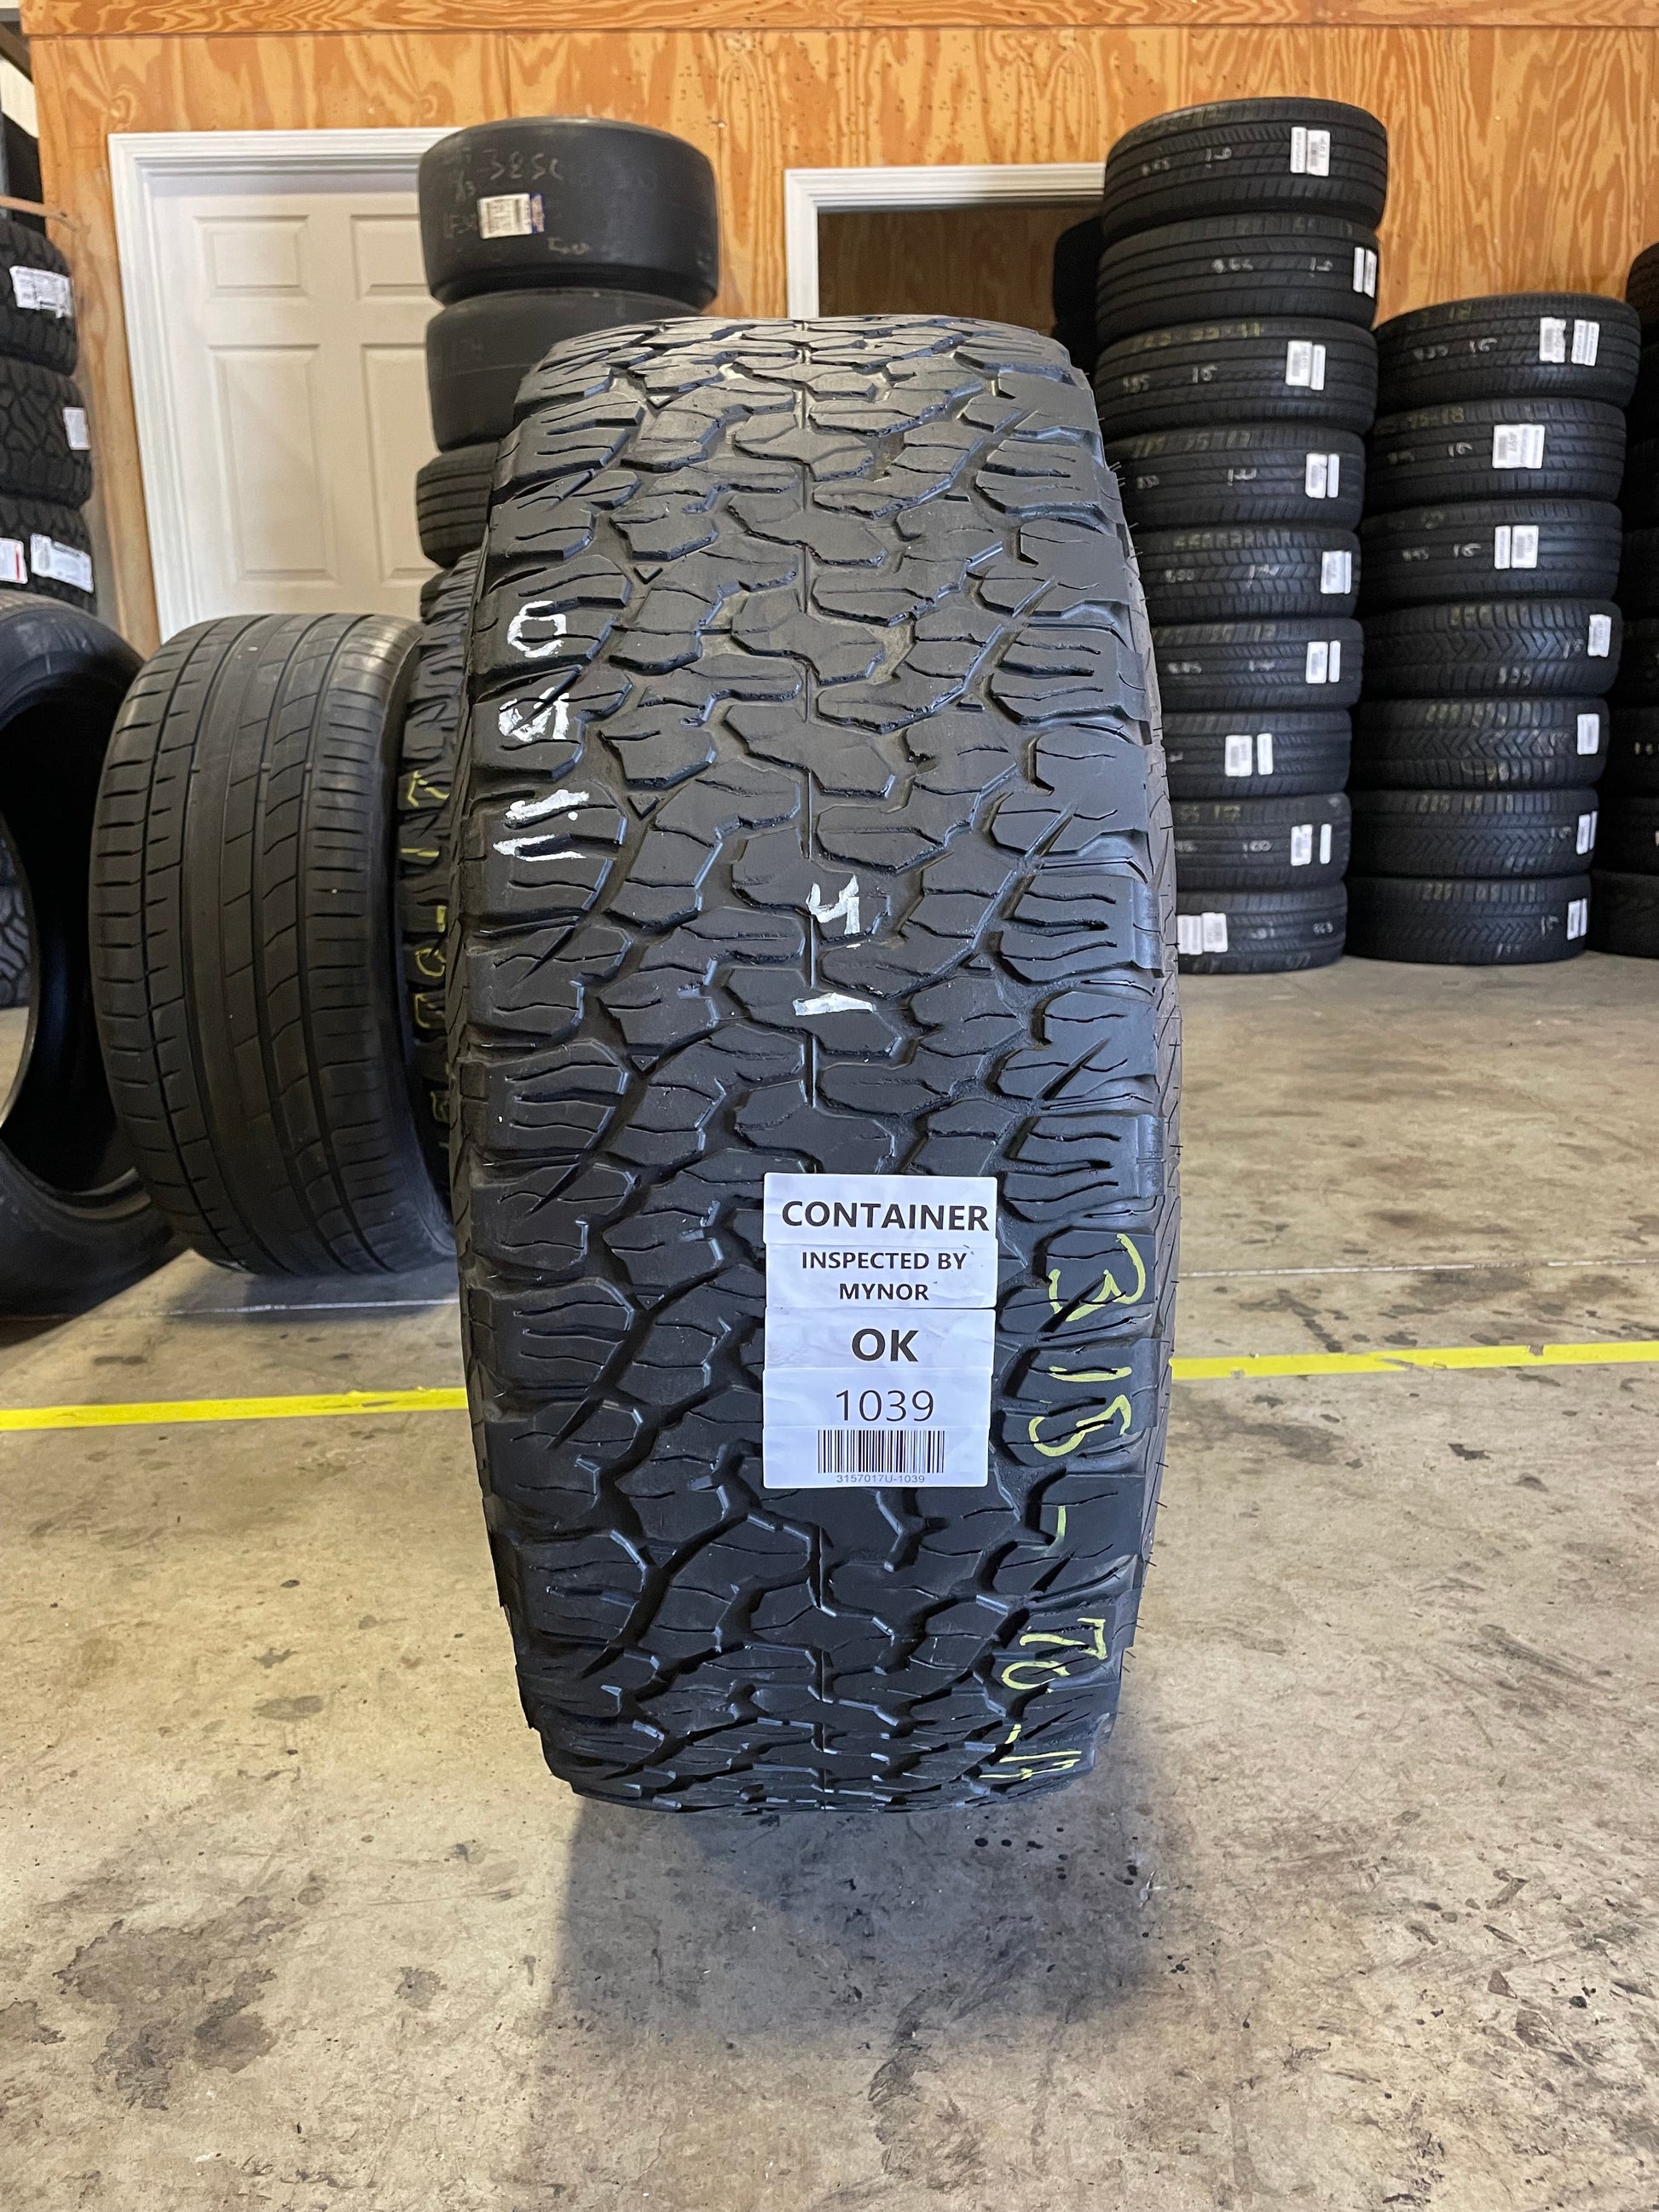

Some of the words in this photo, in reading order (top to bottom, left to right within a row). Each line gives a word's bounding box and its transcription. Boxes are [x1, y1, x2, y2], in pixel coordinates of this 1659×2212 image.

[782, 1200, 990, 1232] CONTAINER
[801, 1251, 930, 1270] INSPECTED
[938, 1252, 968, 1270] BY
[839, 1283, 930, 1302] MYNOR
[851, 1327, 920, 1363] OK
[835, 1389, 935, 1423] 1039
[835, 1474, 926, 1484] 3157017U-1039
